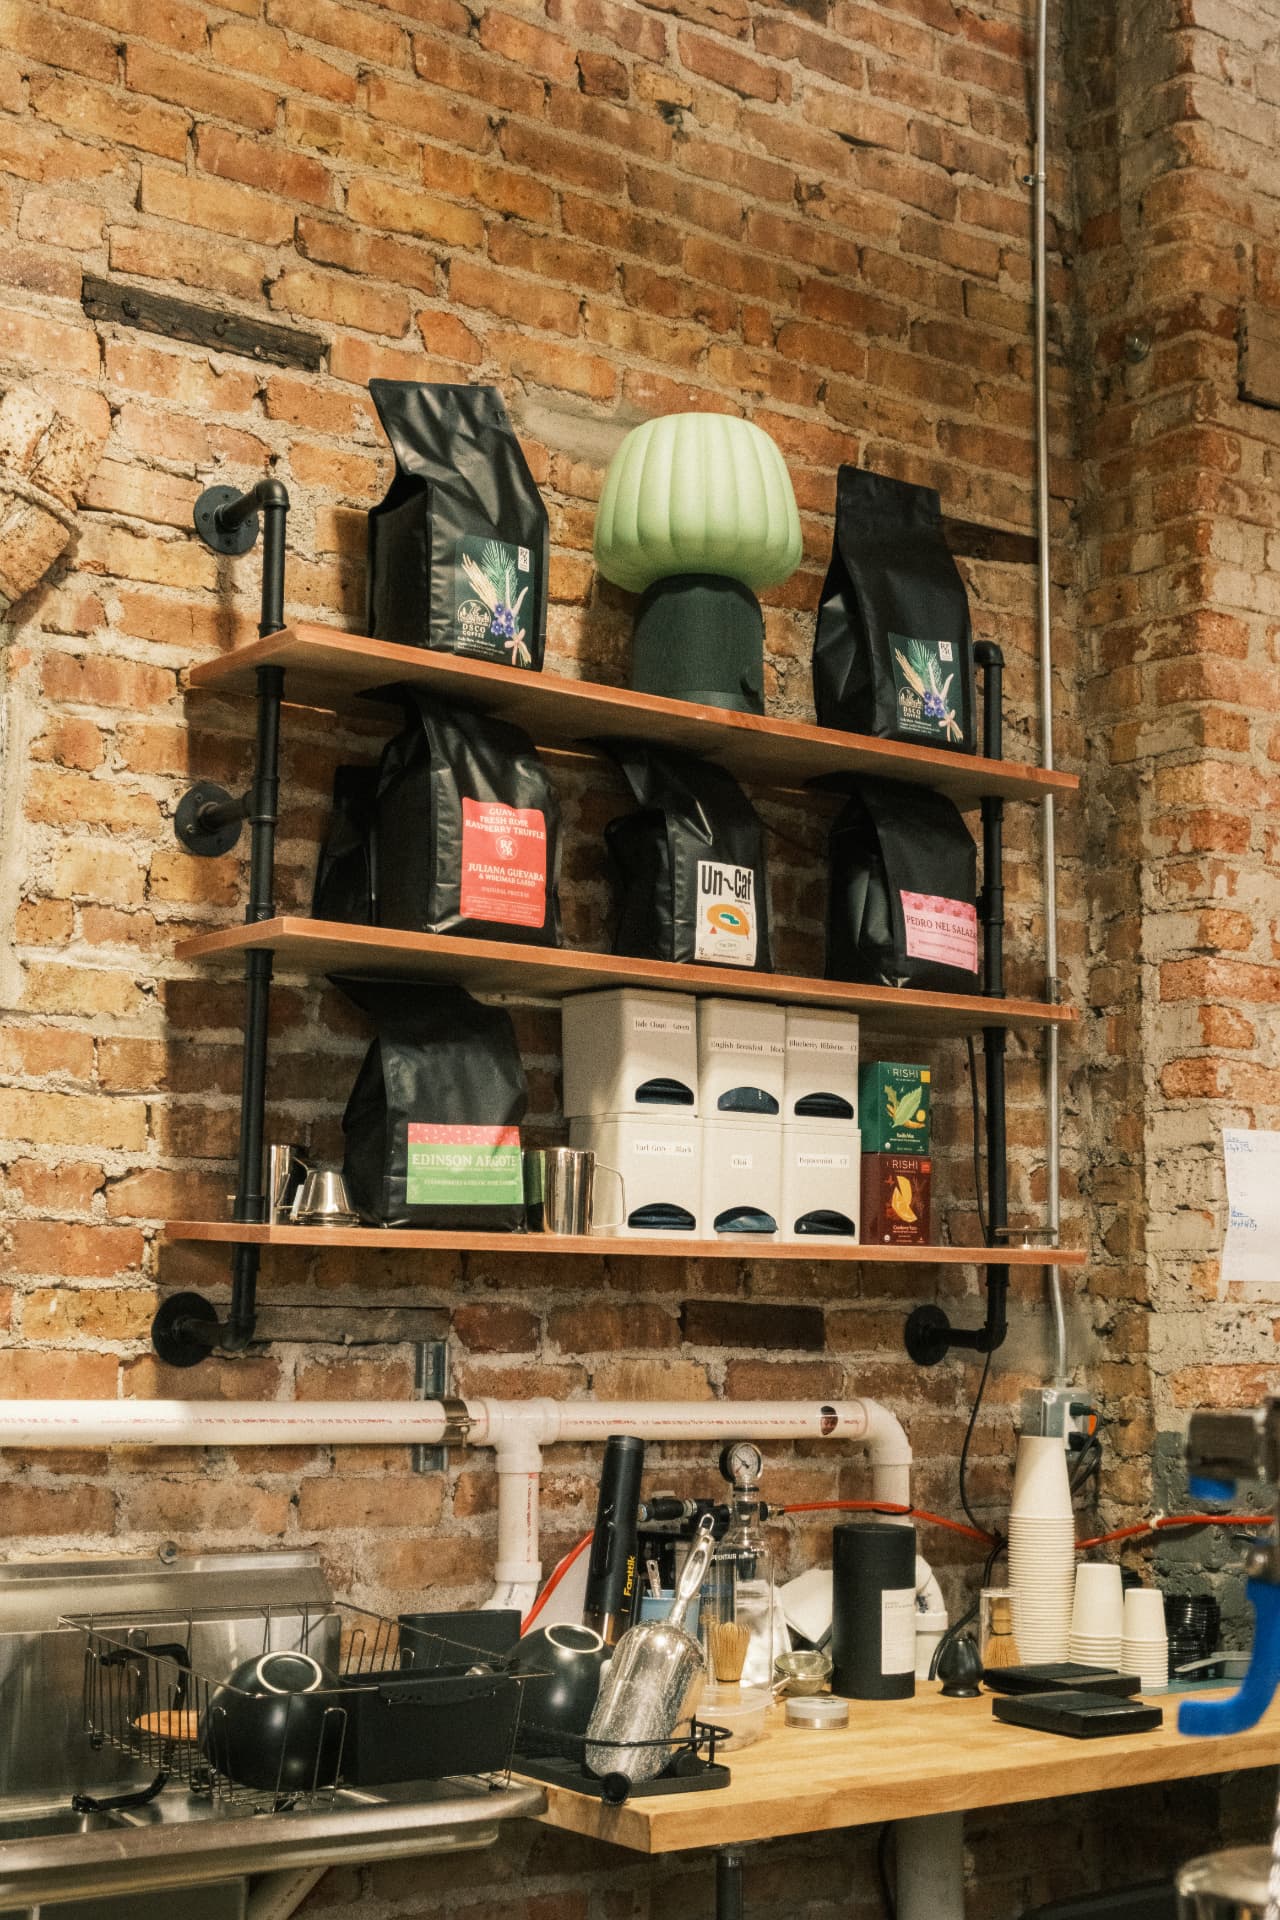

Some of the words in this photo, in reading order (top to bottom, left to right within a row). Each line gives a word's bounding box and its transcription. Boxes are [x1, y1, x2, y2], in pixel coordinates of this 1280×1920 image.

[462, 623, 486, 634] DSCO
[462, 630, 486, 639] COFFEE
[465, 819, 512, 834] RASPBERRY
[513, 827, 545, 840] TRUFFLE
[467, 863, 505, 875] JULIANA
[507, 868, 545, 882] GUEVARA
[906, 914, 933, 929] PEDRO
[935, 921, 951, 932] NEL
[711, 1039, 734, 1049] English
[892, 1068, 919, 1079] RISHI
[635, 1143, 649, 1152] Earl
[411, 1153, 473, 1167] EDINSON
[475, 1154, 518, 1168] ARGOTE
[892, 1159, 919, 1170] RISHI
[623, 1554, 637, 1598] Fanttik
